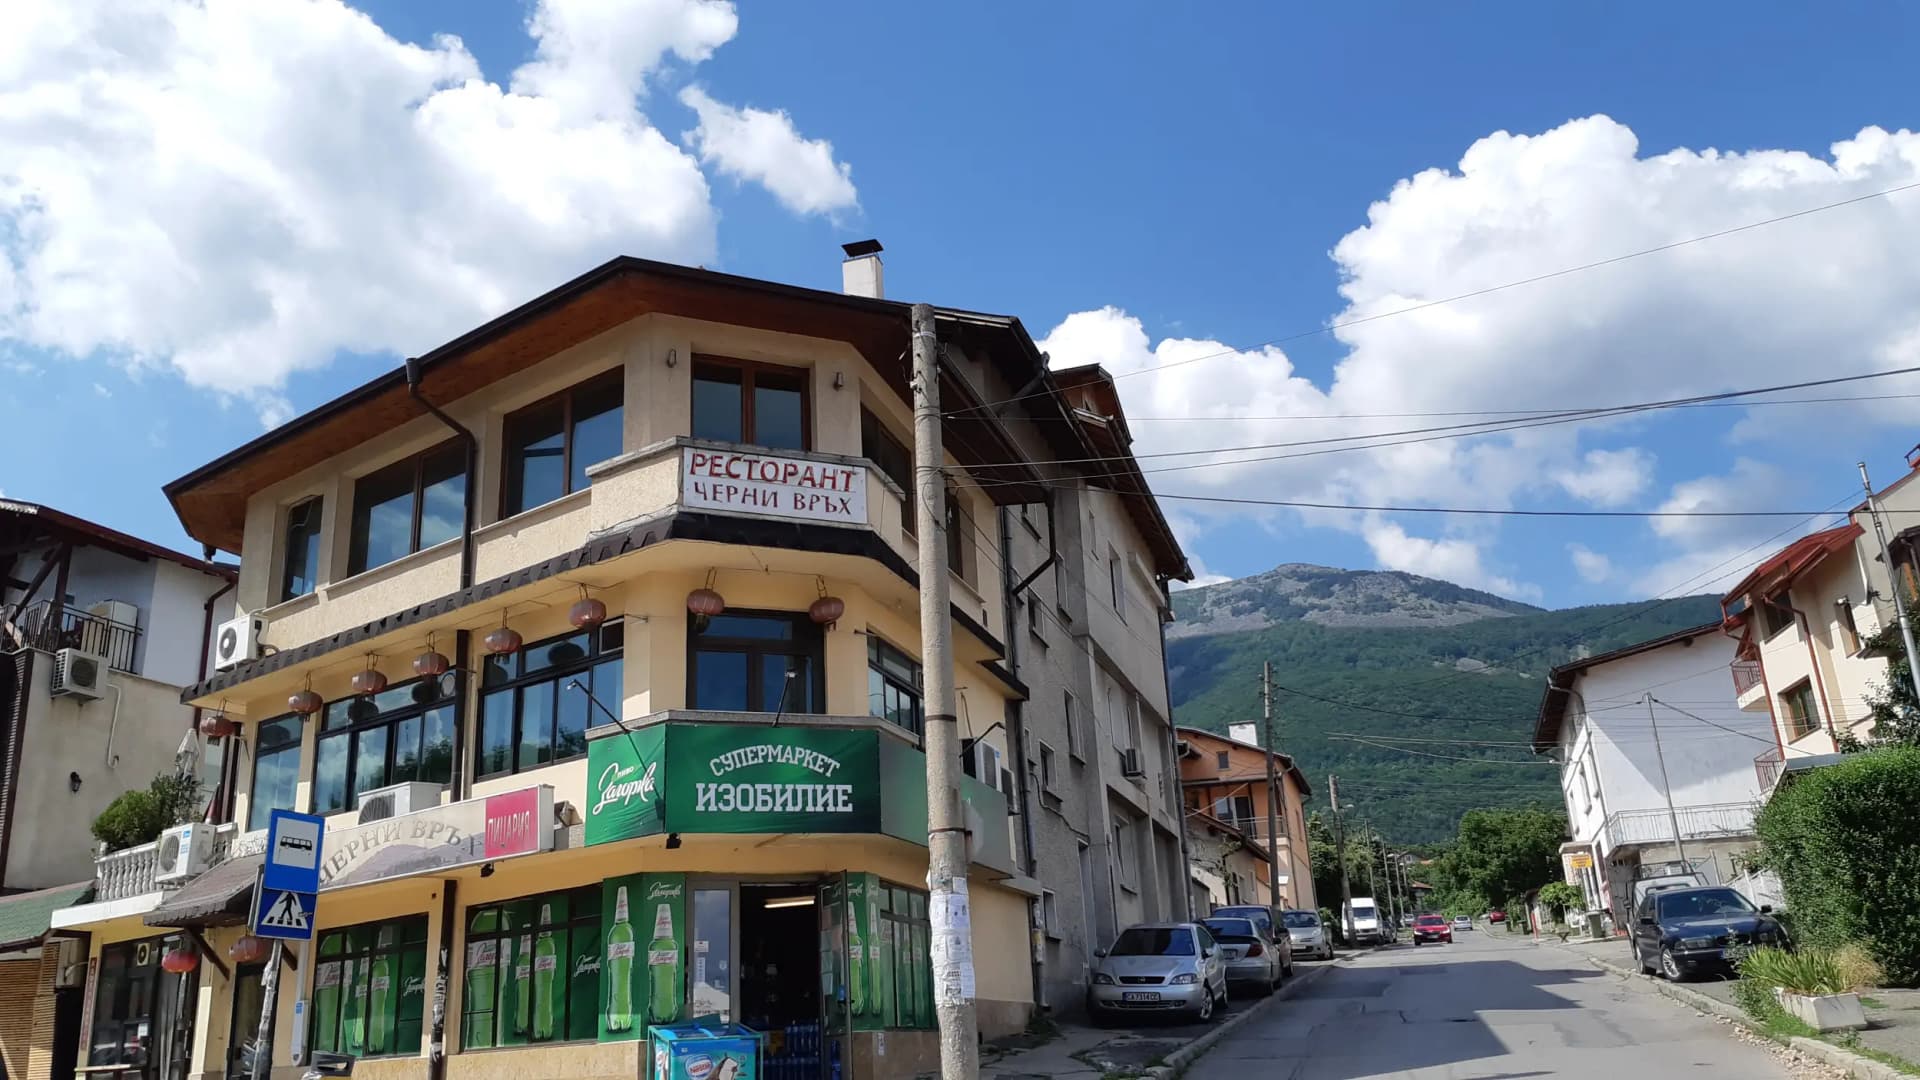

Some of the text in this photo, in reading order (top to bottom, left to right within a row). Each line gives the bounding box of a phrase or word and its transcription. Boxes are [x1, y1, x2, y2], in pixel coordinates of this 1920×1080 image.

[689, 453, 858, 492] РЕСТОРАНТ
[694, 481, 852, 515] ЧЕРНИ ВРЪХ
[709, 744, 841, 777] СУПЕРМАРКЕТ
[695, 783, 853, 812] ИЗОБИЛИЕ
[487, 809, 531, 846] ПИЦАРИЯ
